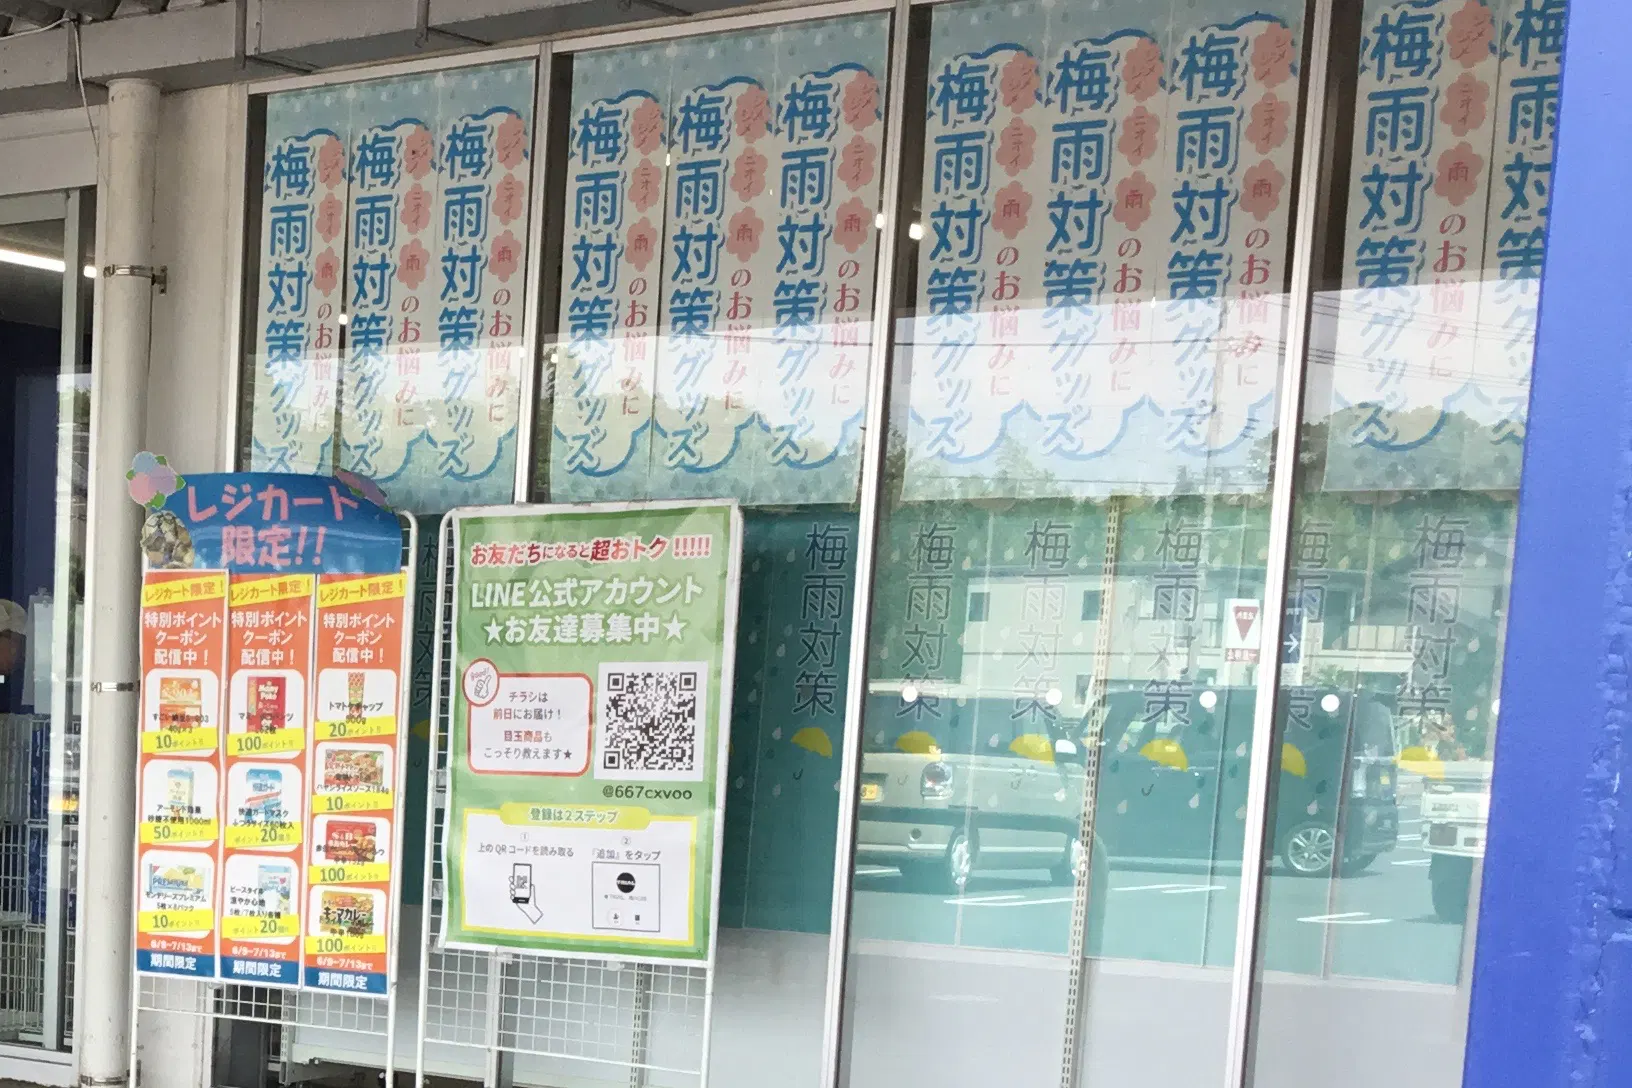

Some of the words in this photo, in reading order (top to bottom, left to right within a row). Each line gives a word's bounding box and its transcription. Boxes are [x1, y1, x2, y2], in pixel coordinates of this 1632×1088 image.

[1353, 11, 1435, 436] 梅雨対策グッズ
[1166, 34, 1240, 442] 梅雨対策グッズ
[926, 62, 990, 450] 梅雨対策グッズ
[1042, 49, 1111, 447] 梅雨対策グッズ
[669, 95, 725, 461] 梅雨対策グッズ
[772, 81, 833, 457] 梅雨対策グッズ
[567, 107, 622, 465] 梅雨対策グッズ
[350, 133, 396, 473] 梅雨対策グッズ
[438, 124, 487, 470] 梅雨対策グッズ
[188, 483, 359, 522] レジカート
[221, 525, 327, 566] 限定!!
[470, 574, 705, 609] LINE公式アカウント
[144, 611, 222, 629] 特別ポイント
[231, 610, 308, 629] 特別ポイント
[323, 612, 395, 629] 特別ポイント
[793, 522, 850, 717] 梅雨対策
[896, 522, 956, 720] 梅雨対策
[155, 629, 208, 646] クーポン
[242, 629, 294, 646] クーポン
[333, 629, 383, 646] クーポン
[154, 648, 209, 666] 配信中!
[240, 648, 295, 666] 配信中!
[332, 647, 384, 664] 配信中!
[508, 690, 548, 704] チラシは
[503, 730, 553, 743] 目玉商品も
[602, 785, 693, 801] @667cxvoo
[150, 952, 197, 971] 期間限定
[232, 959, 282, 978] 期間限定
[317, 971, 368, 990] 期間限定
